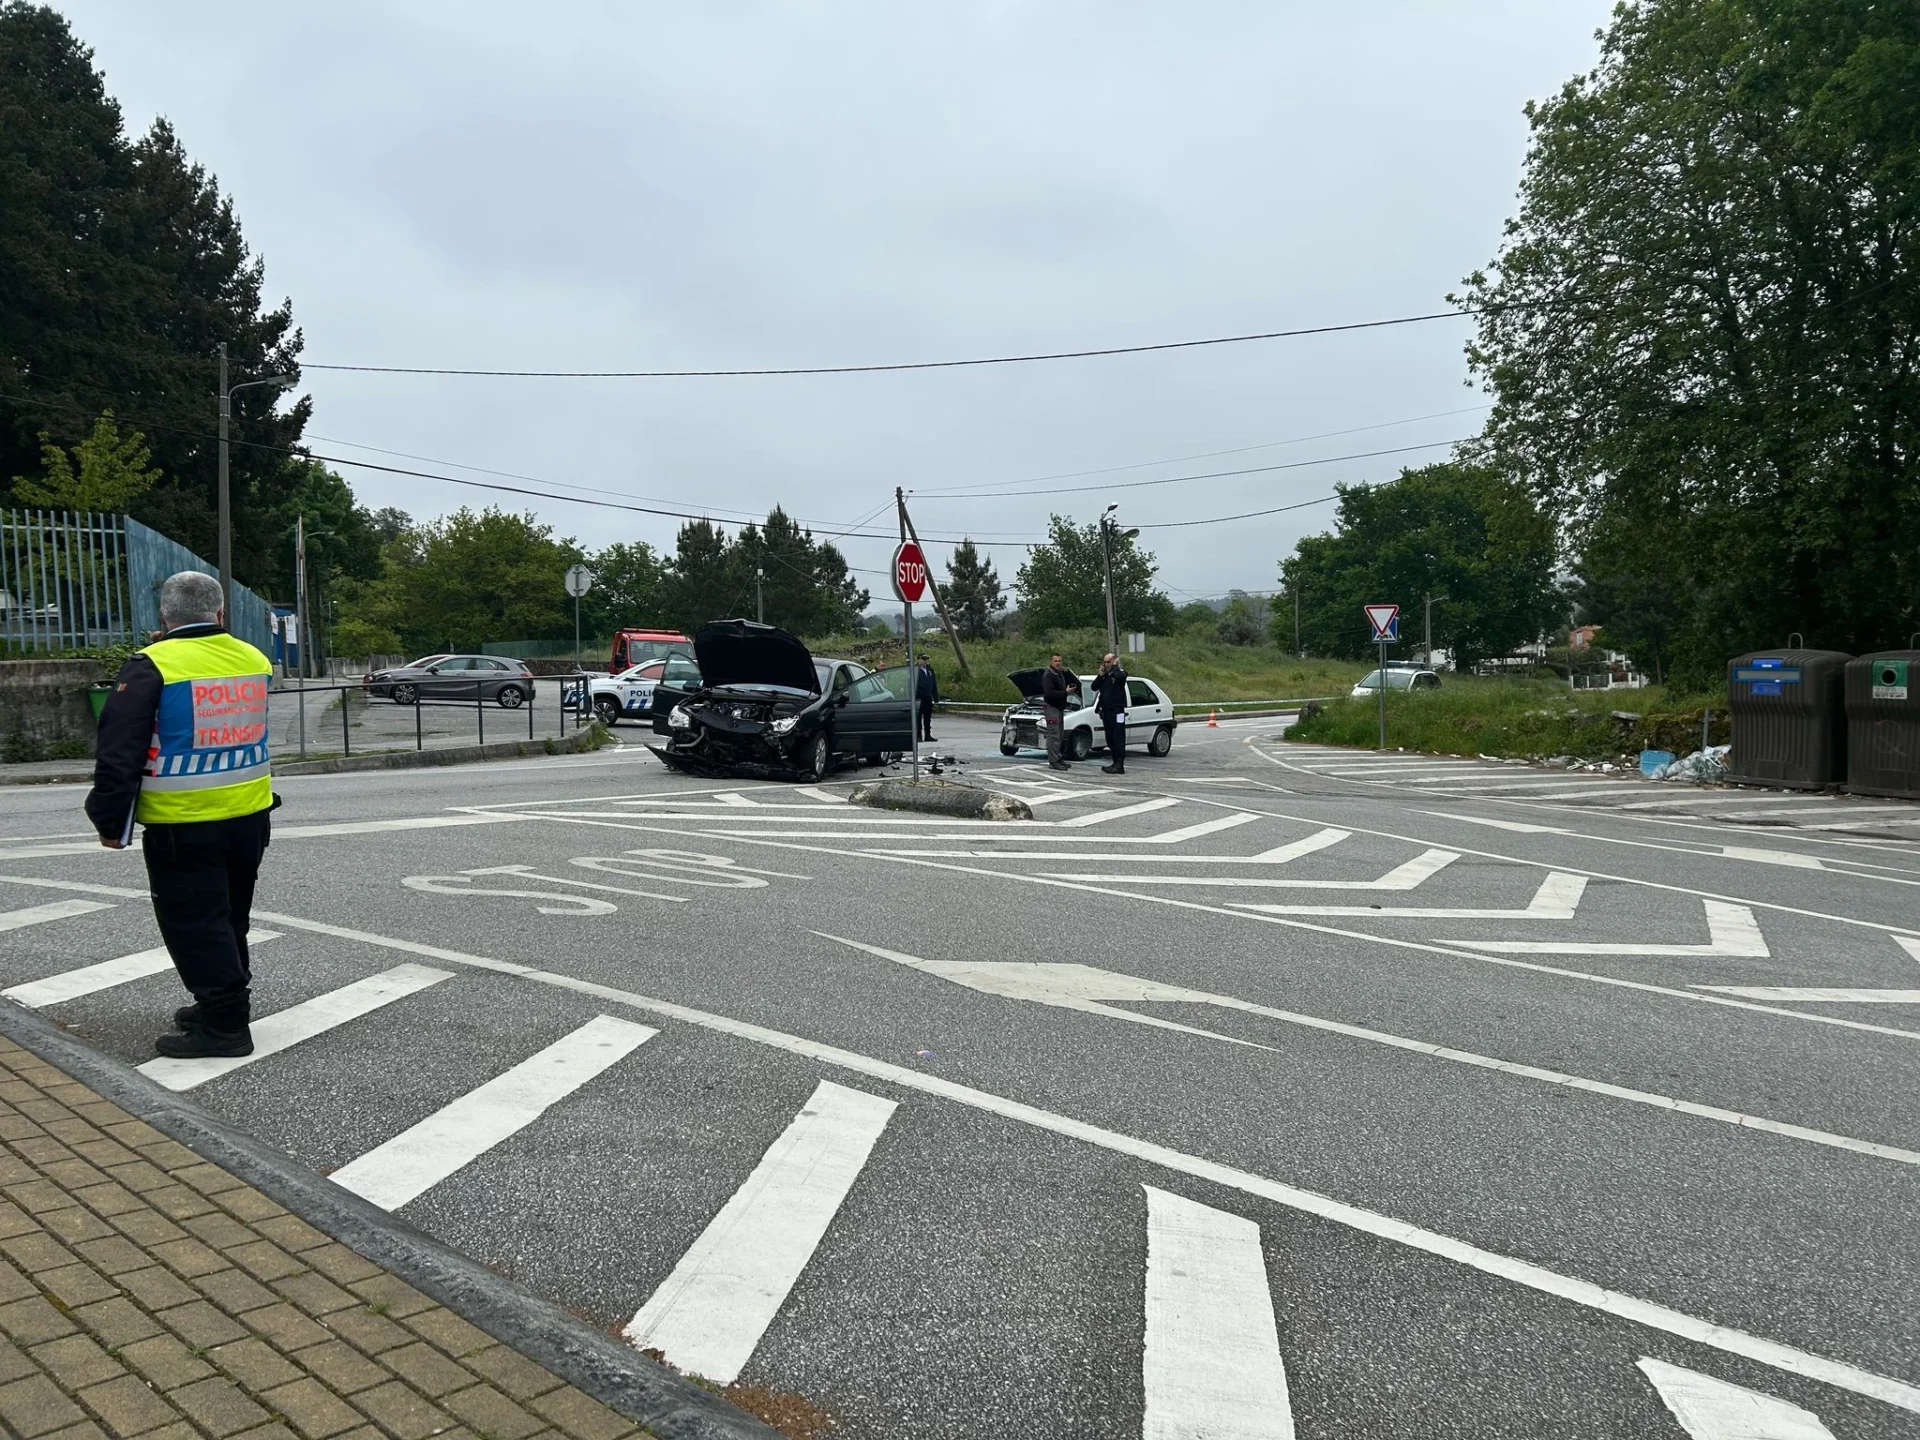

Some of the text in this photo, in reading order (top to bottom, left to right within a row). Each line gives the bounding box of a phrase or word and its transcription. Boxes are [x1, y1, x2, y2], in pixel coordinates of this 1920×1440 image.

[899, 562, 925, 584] STOP
[194, 677, 265, 706] POLÍCIA
[401, 848, 814, 916] STOP
